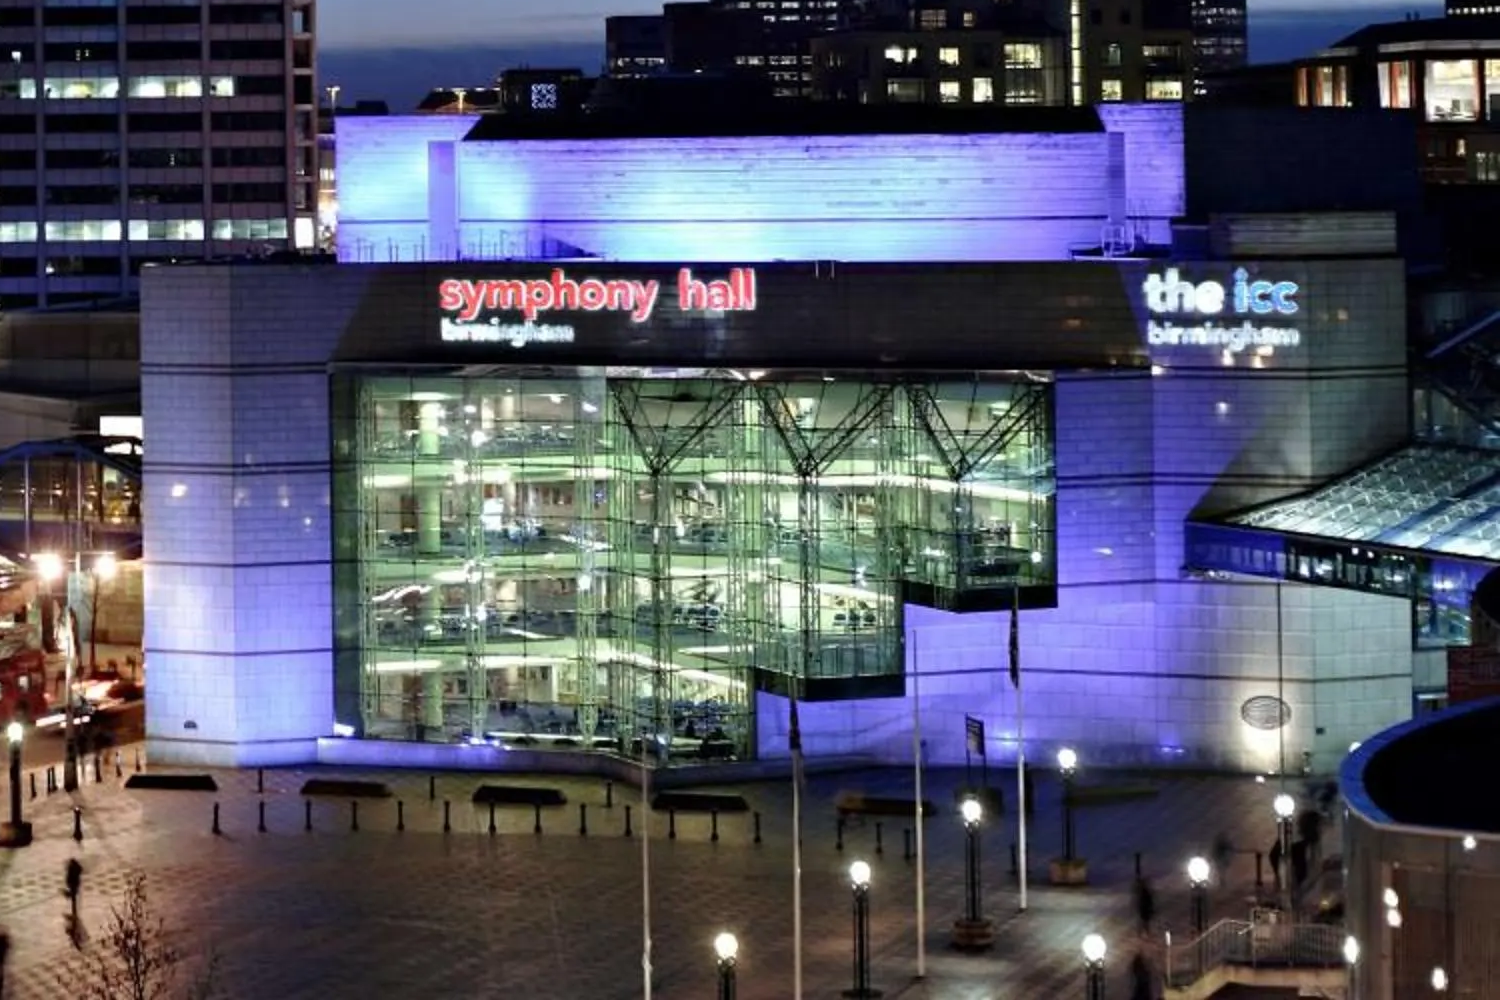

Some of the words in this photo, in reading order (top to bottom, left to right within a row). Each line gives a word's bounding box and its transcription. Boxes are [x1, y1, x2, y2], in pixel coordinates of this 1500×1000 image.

[439, 267, 659, 323] symphony
[677, 267, 757, 310] hall
[1143, 267, 1225, 314] the
[1233, 266, 1300, 314] icc
[1147, 319, 1300, 353] birmingham
